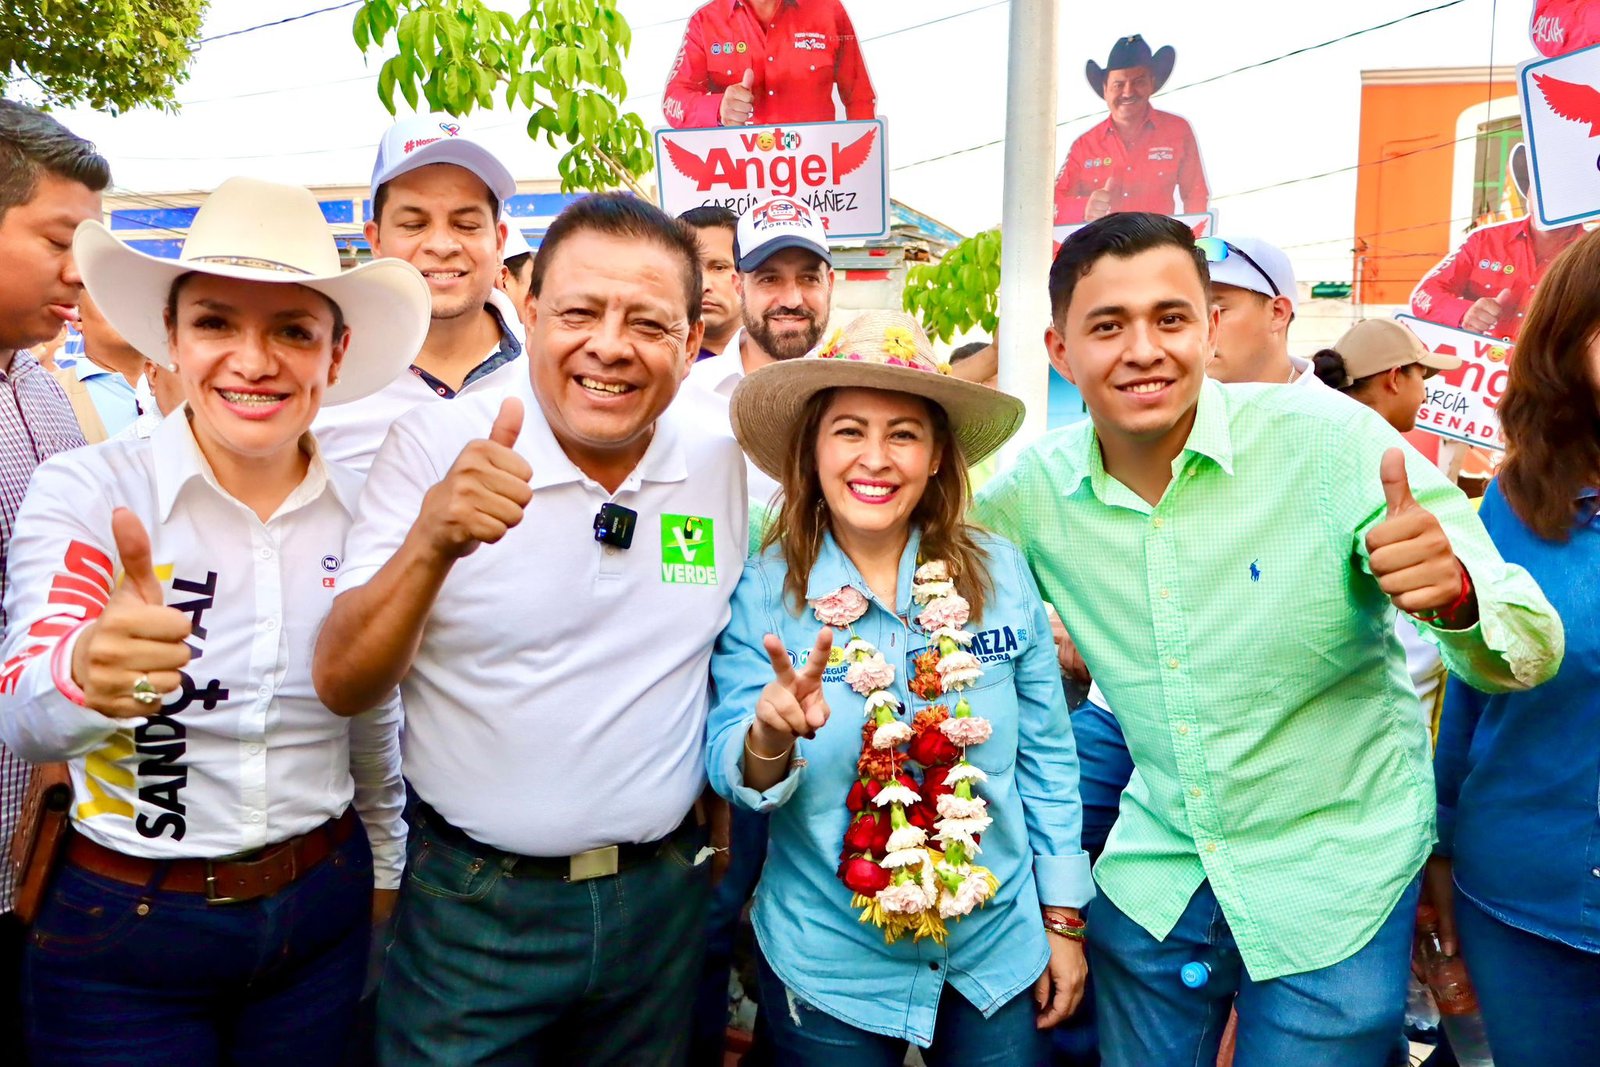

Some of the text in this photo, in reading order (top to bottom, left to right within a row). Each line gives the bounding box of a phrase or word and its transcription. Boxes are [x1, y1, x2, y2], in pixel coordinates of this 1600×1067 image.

[696, 142, 841, 197] Angel
[761, 221, 808, 232] MORELOS
[1417, 408, 1503, 442] SENAD
[663, 563, 717, 584] VERDE
